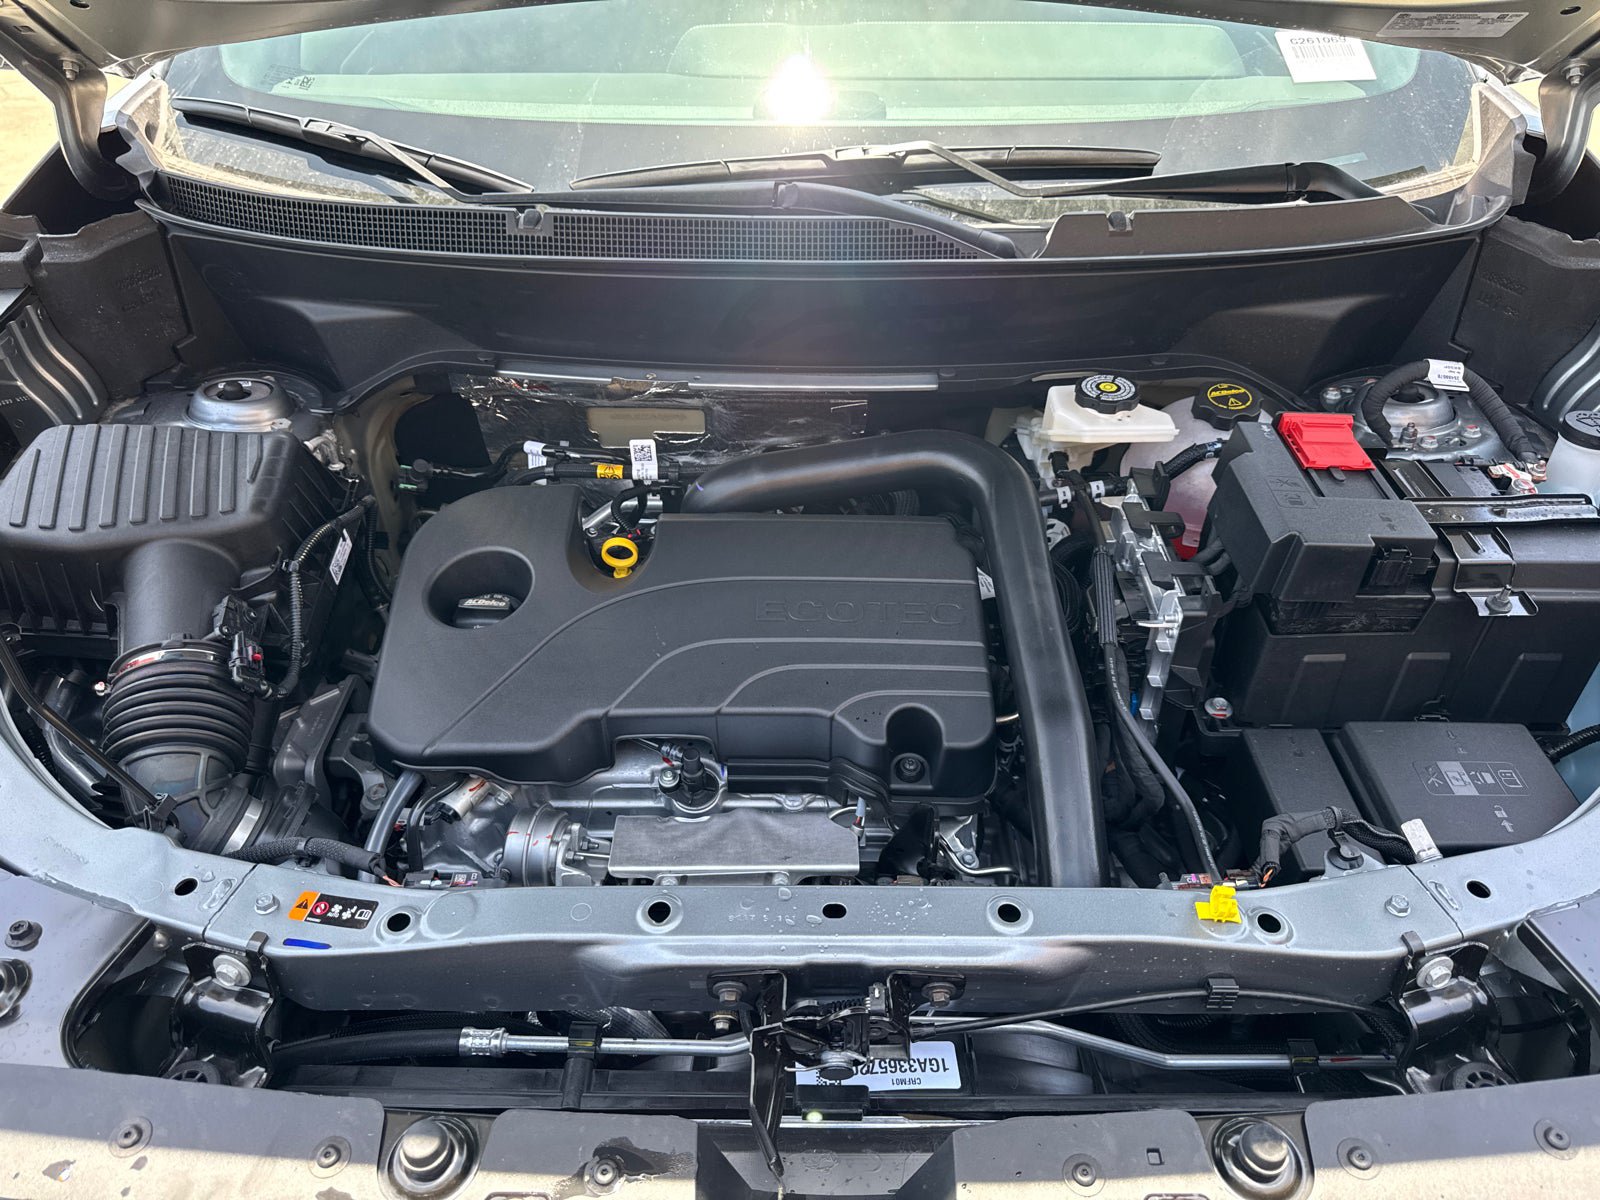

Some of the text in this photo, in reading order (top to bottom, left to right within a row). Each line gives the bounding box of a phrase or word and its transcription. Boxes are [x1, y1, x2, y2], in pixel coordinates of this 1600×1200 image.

[463, 598, 506, 607] ACDelco
[755, 600, 968, 625] ECOTEC
[890, 1077, 922, 1086] CRFM01
